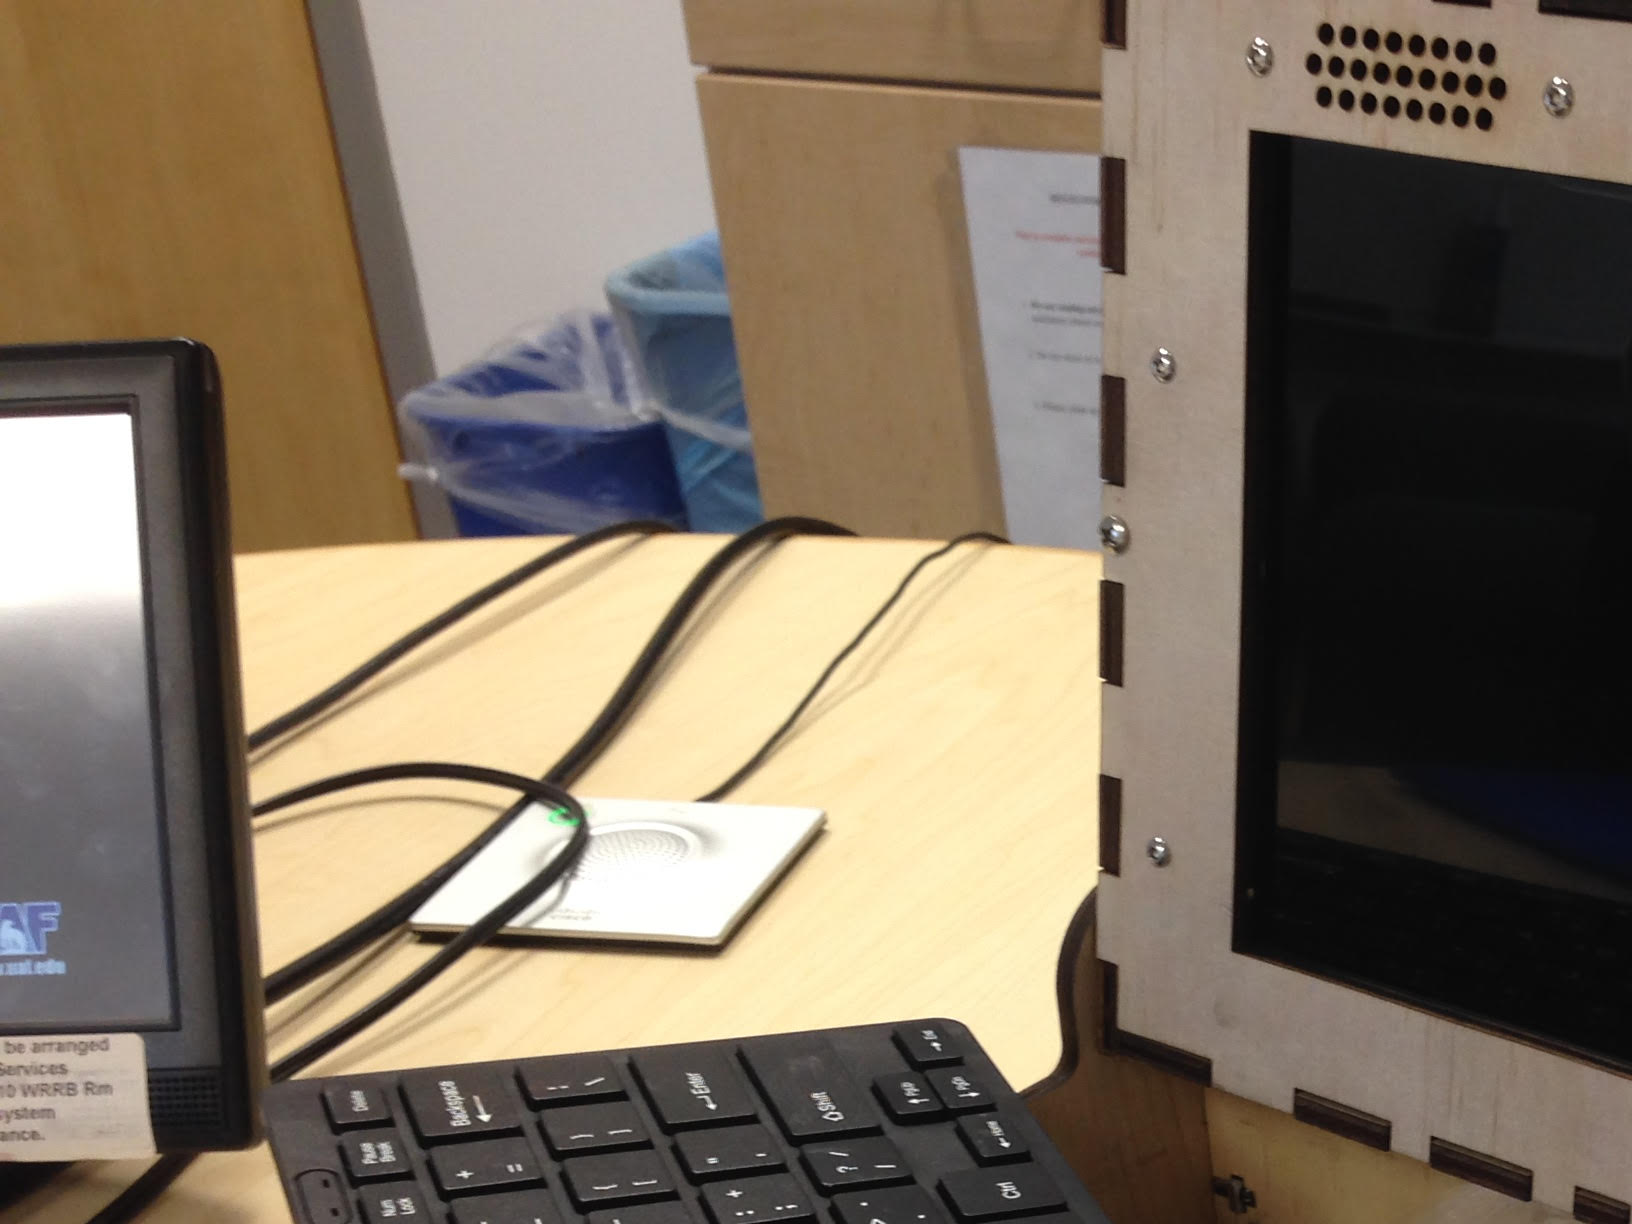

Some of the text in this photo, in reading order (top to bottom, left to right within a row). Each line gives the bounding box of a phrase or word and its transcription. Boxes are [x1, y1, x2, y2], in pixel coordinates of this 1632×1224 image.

[4, 1037, 111, 1056] be arranged
[20, 1082, 79, 1098] WRRB
[83, 1080, 114, 1097] Rm
[438, 1080, 472, 1127] Backspace
[456, 1170, 474, 1179] +
[506, 1163, 523, 1173] =
[836, 1165, 859, 1174] ?
[726, 1189, 743, 1198] +
[996, 1181, 1022, 1200] Ctrl
[380, 1199, 397, 1217] Num
